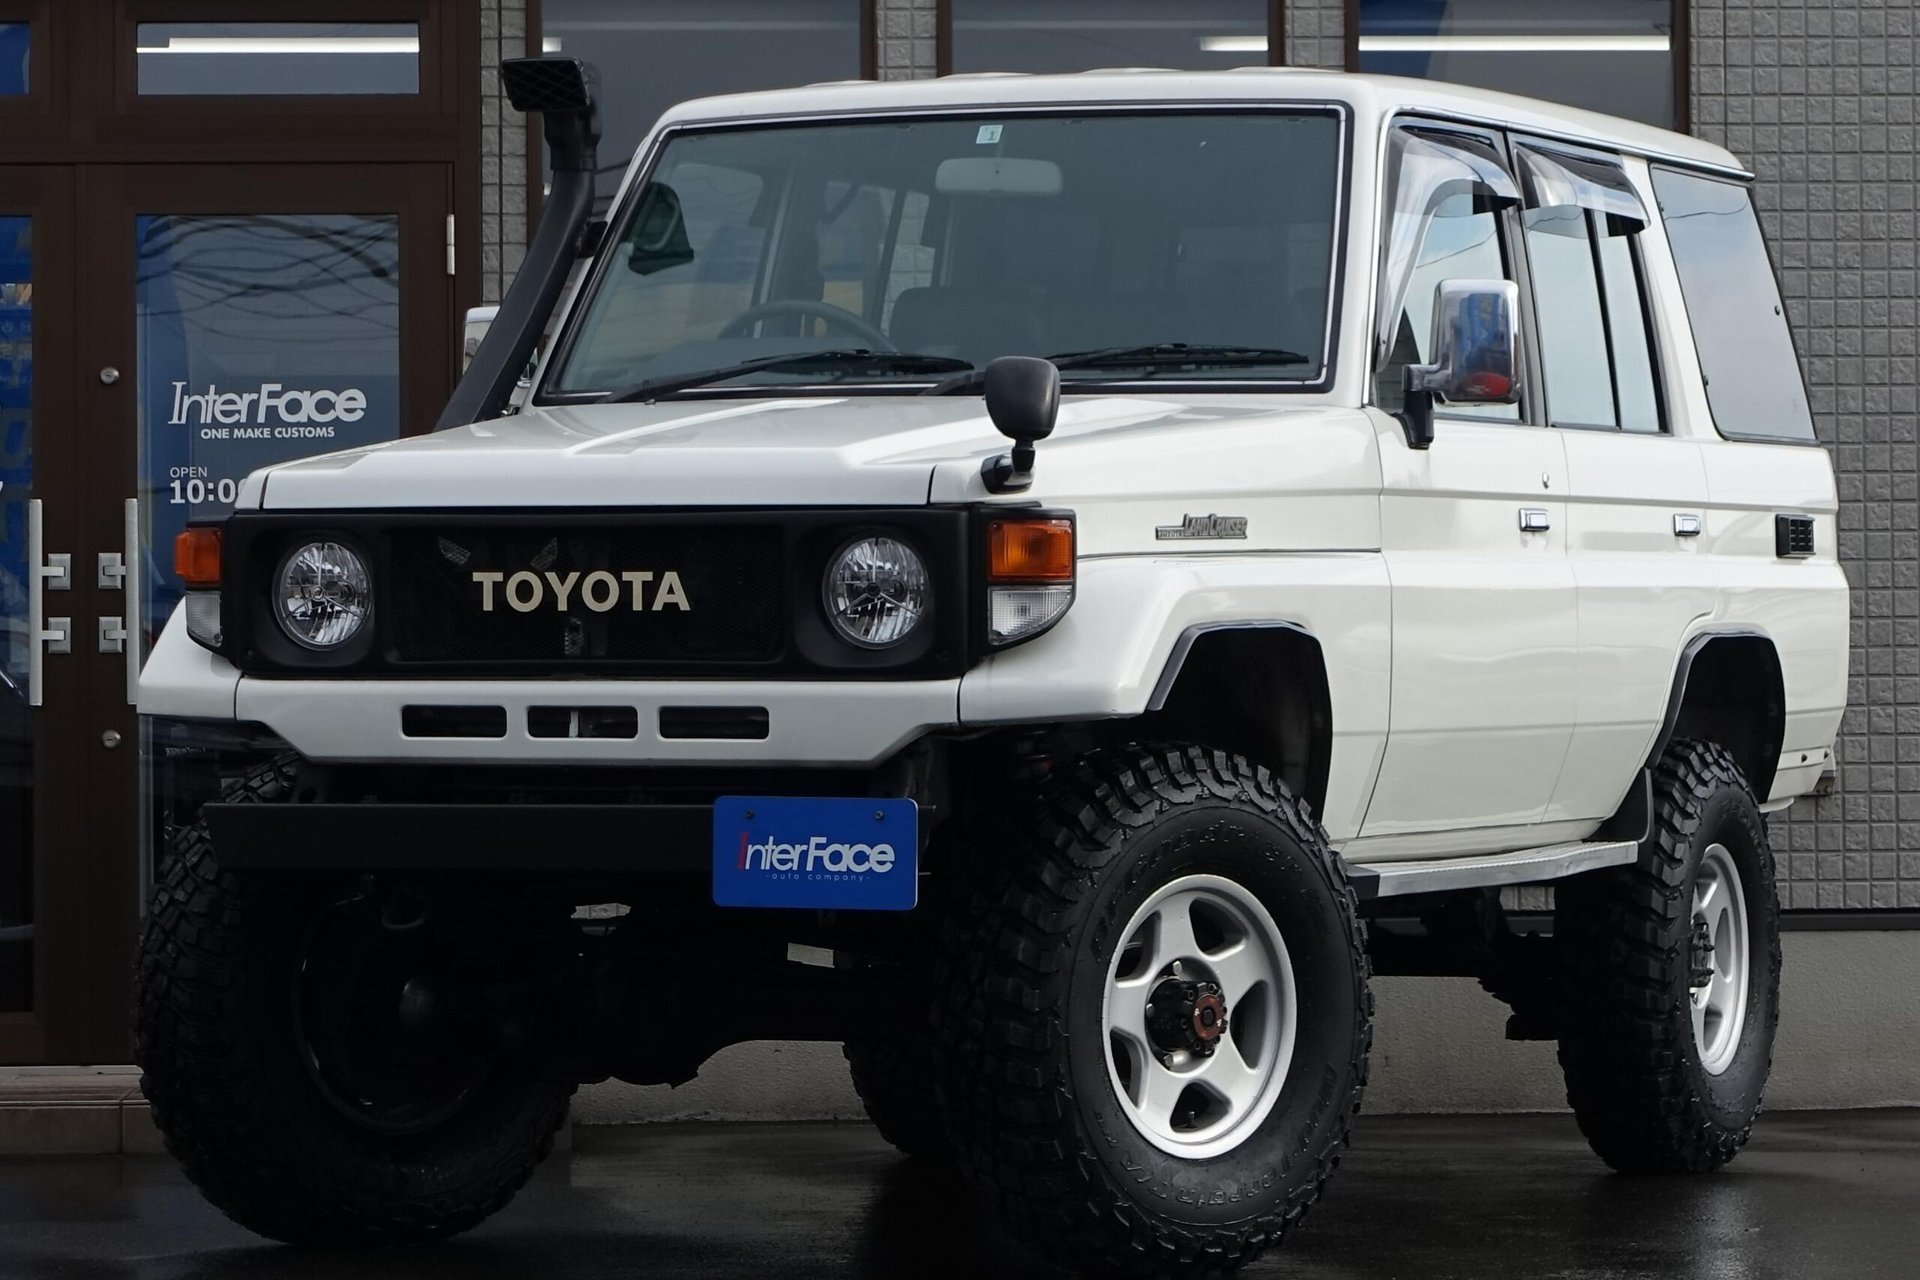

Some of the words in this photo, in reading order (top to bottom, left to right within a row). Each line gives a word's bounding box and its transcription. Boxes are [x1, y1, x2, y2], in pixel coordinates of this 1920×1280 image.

[168, 381, 367, 424] InterFace
[200, 428, 230, 440] ONE
[233, 427, 271, 439] MAKE
[274, 426, 335, 438] CUSTOMS
[170, 466, 208, 478] OPEN
[472, 570, 691, 613] TOYOTA
[736, 831, 896, 873] InterFace
